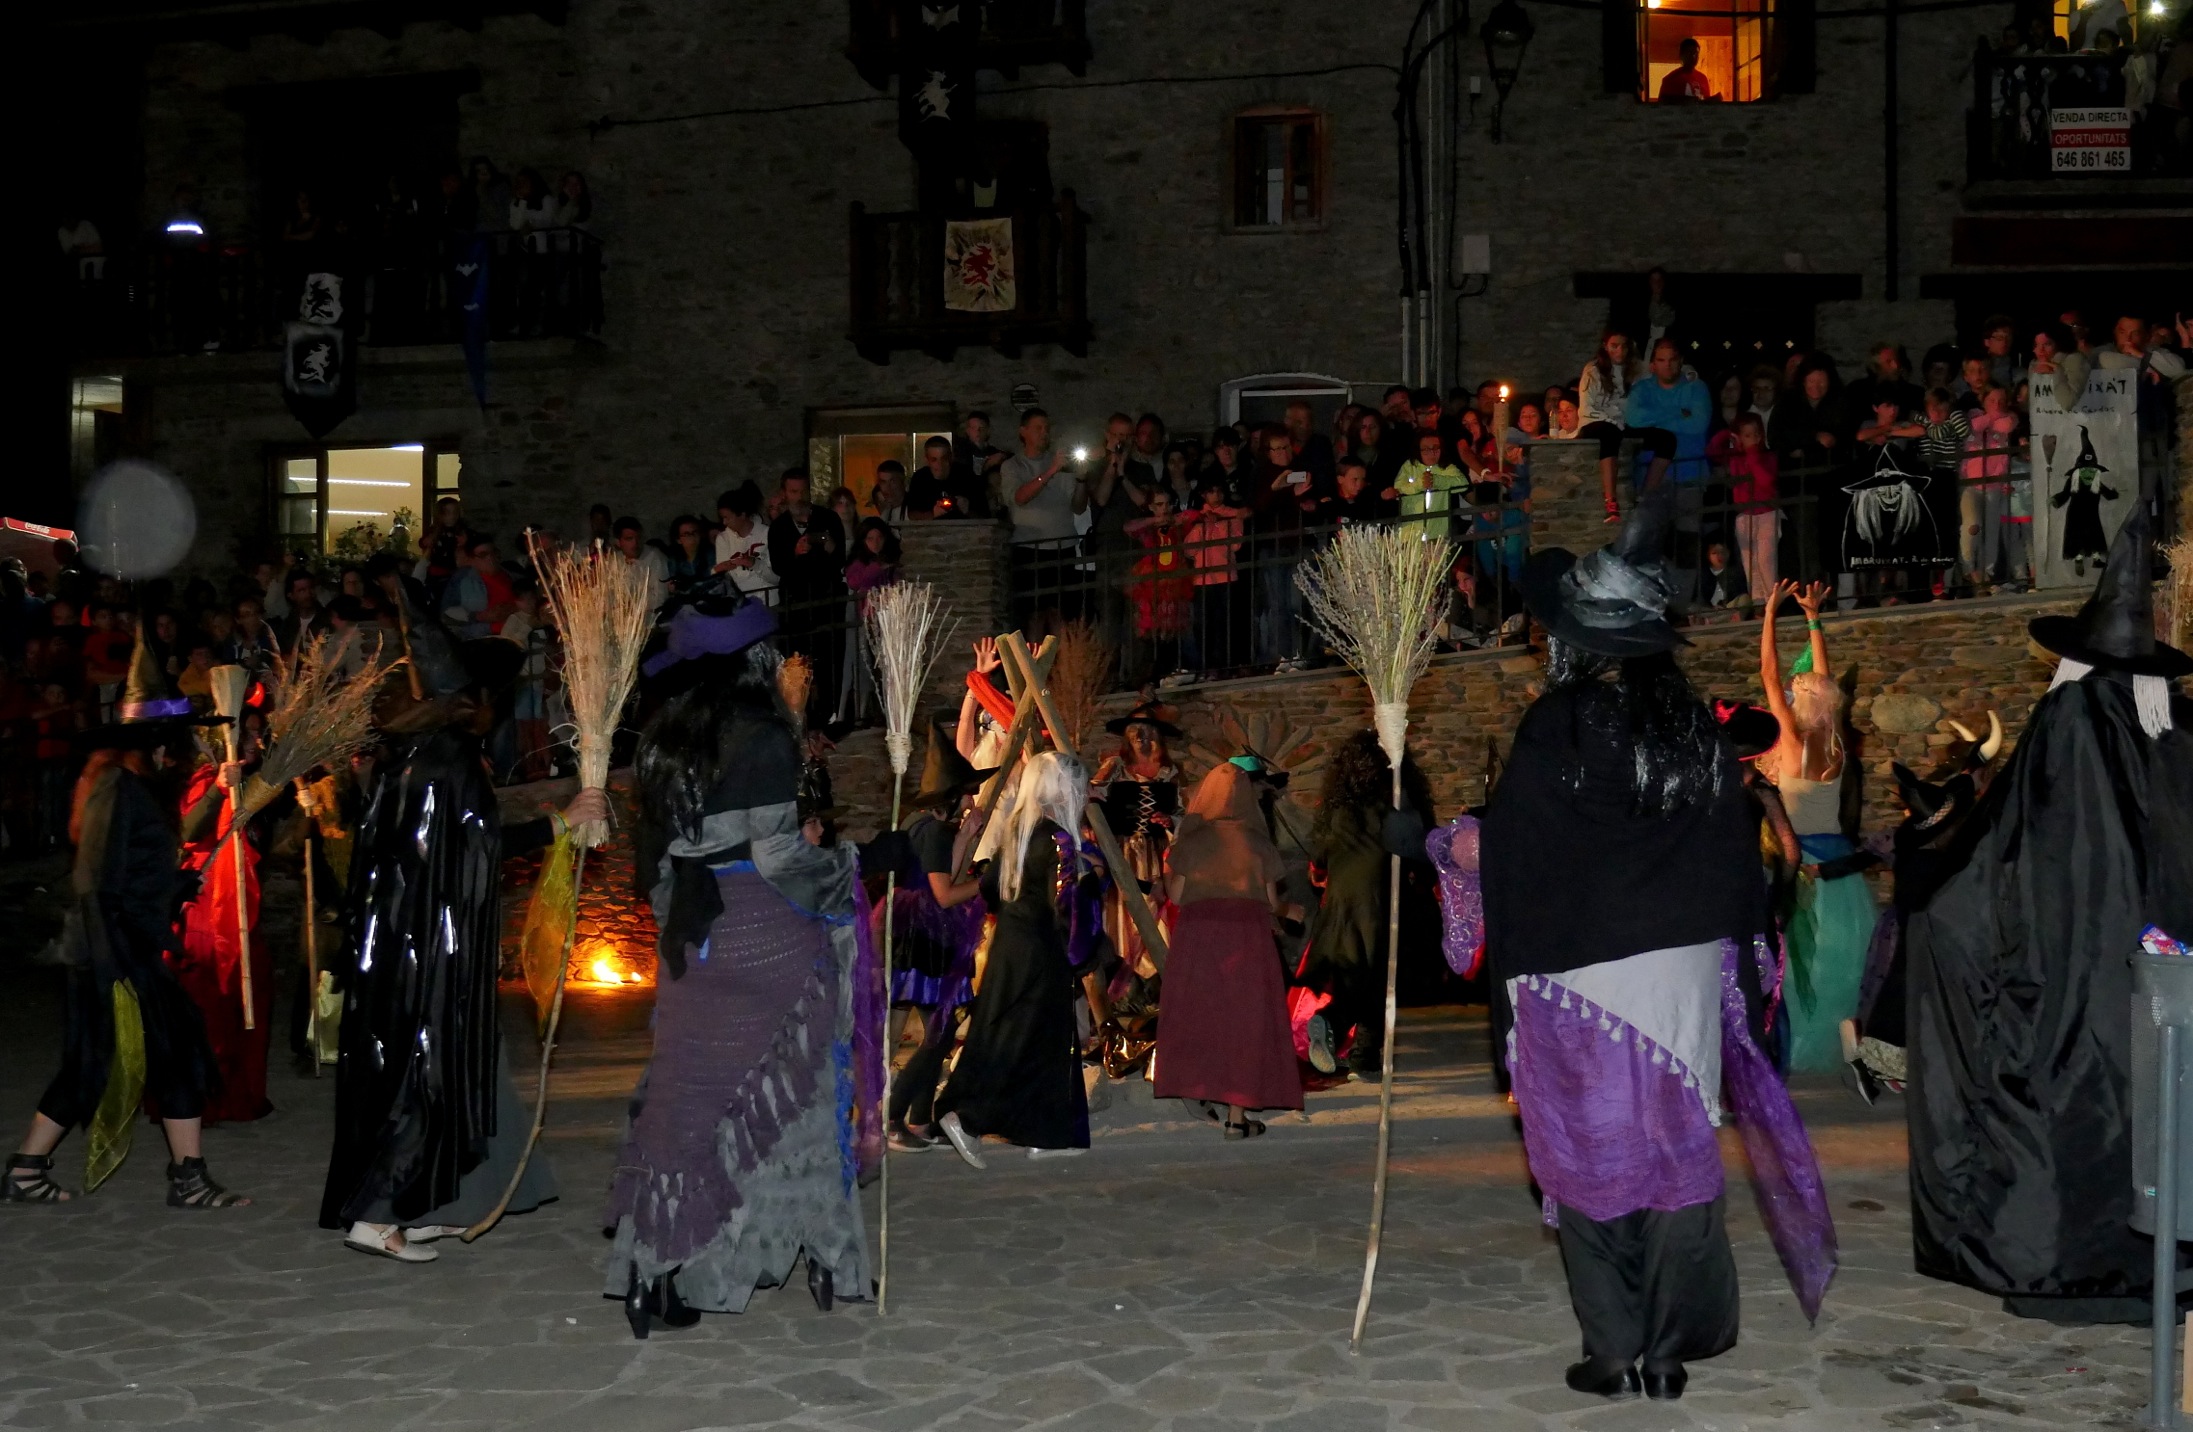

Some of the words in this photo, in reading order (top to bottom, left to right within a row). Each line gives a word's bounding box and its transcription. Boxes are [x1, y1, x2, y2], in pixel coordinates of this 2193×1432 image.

[2053, 113, 2085, 123] VENDA
[2088, 112, 2128, 121] DIRECTA
[2055, 133, 2127, 144] OPORTUNITATS
[2057, 151, 2077, 167] 646
[2081, 151, 2100, 167] 861
[2104, 150, 2125, 166] 465
